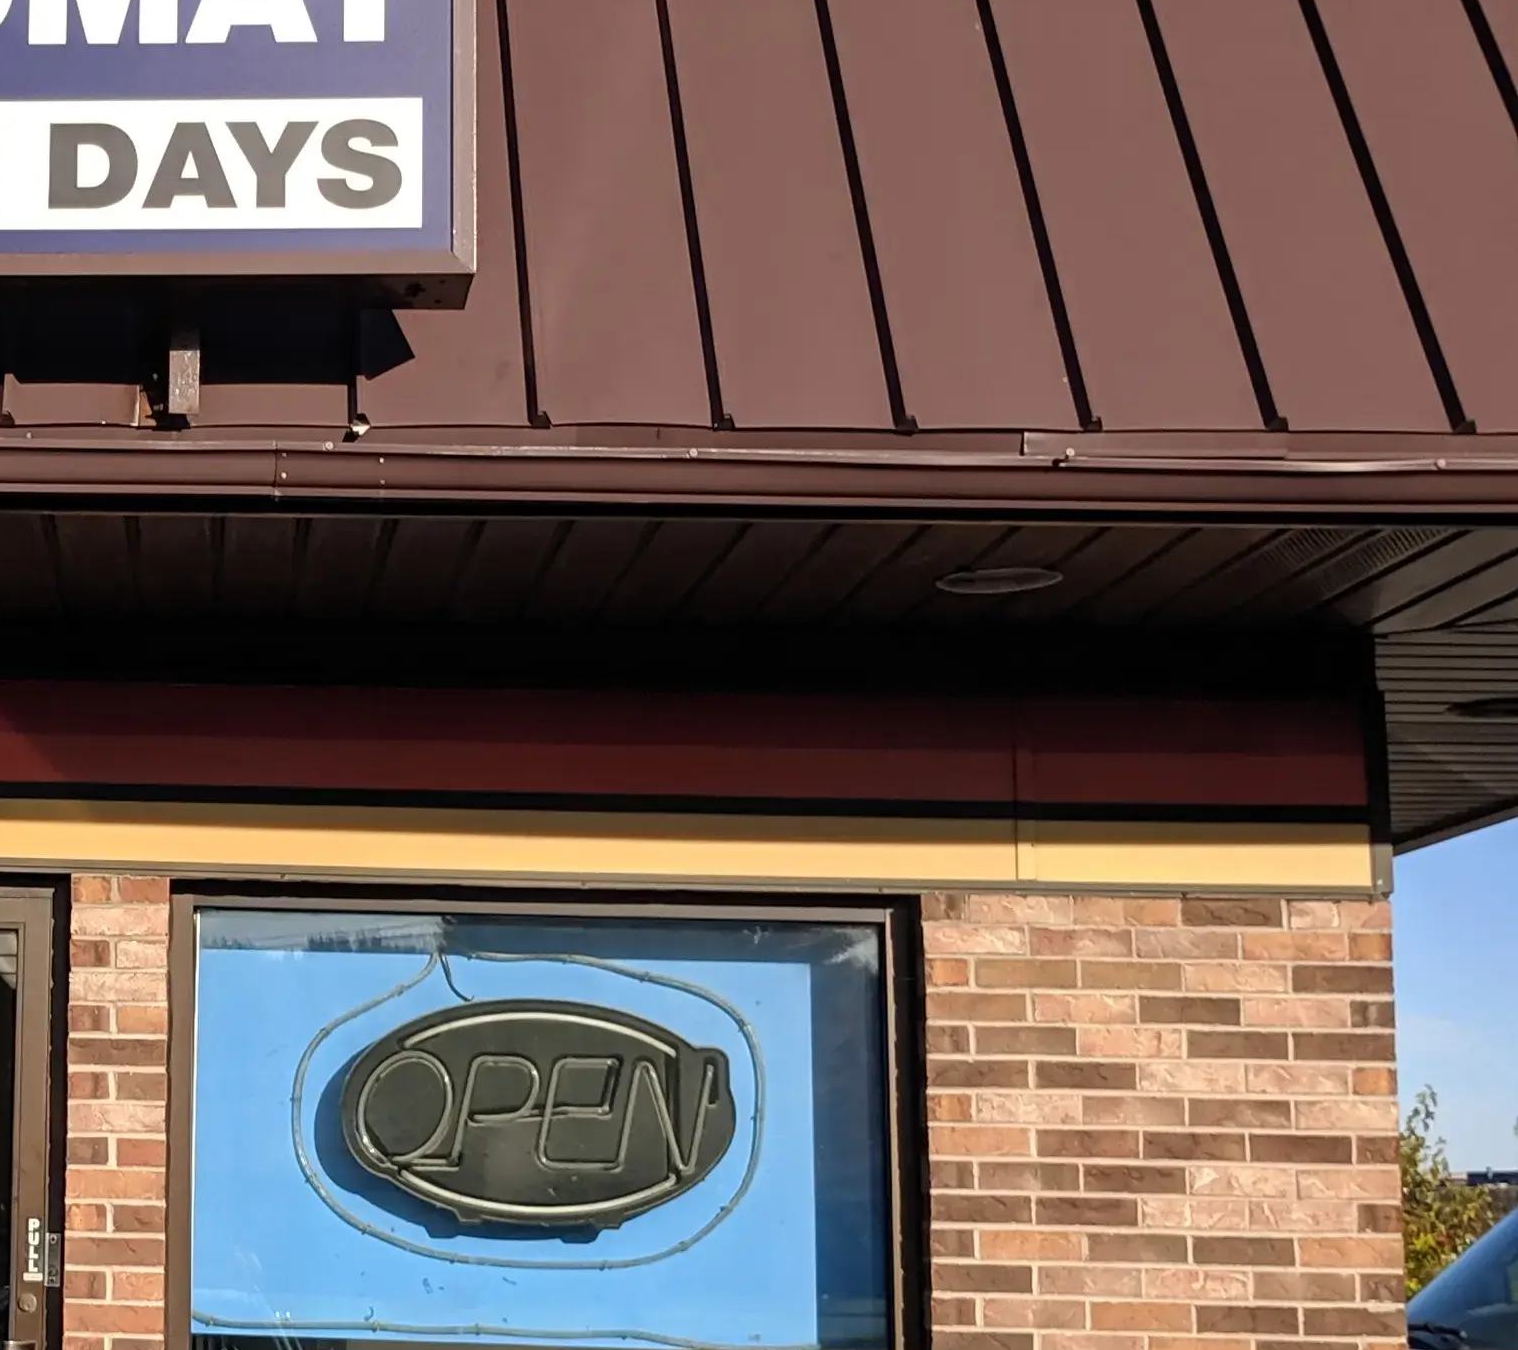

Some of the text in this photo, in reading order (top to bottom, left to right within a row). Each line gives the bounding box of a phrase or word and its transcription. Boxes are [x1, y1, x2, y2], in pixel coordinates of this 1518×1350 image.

[47, 118, 405, 211] DAYS
[356, 1048, 720, 1174] OPEN
[28, 1218, 41, 1273] PULL
